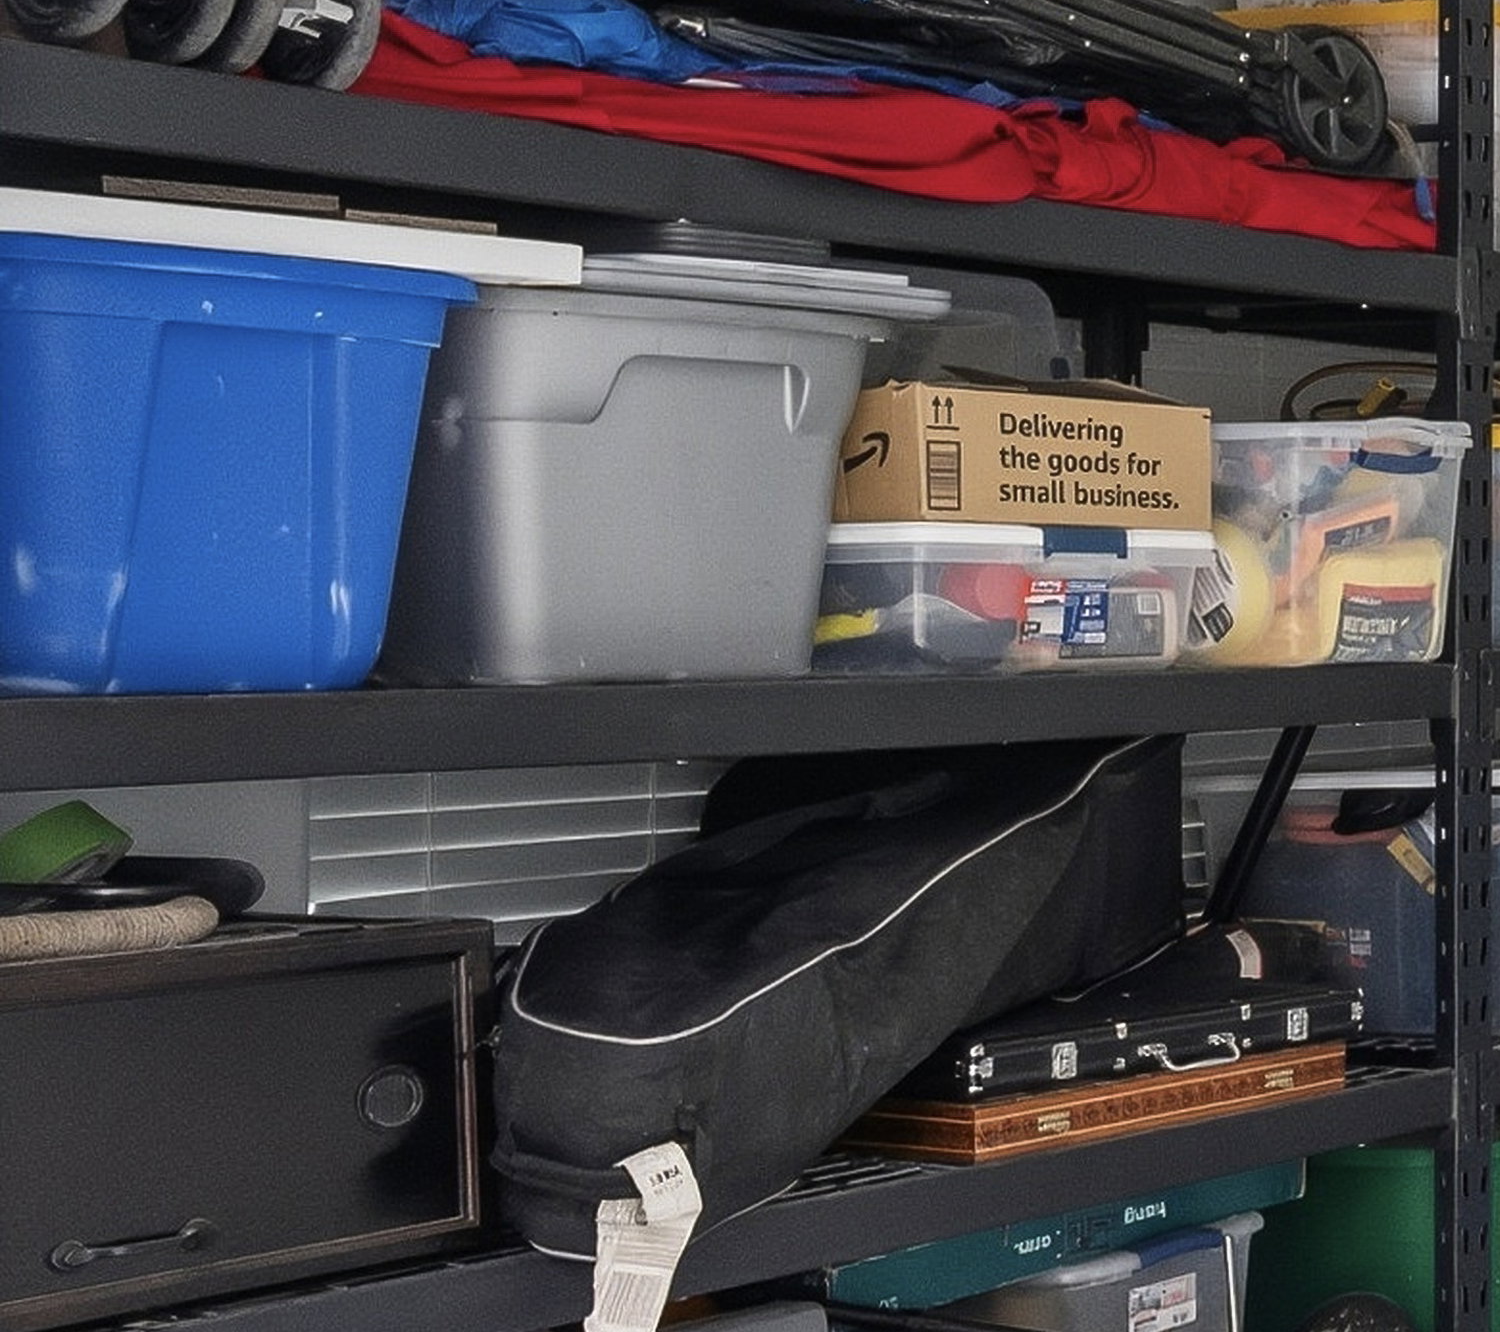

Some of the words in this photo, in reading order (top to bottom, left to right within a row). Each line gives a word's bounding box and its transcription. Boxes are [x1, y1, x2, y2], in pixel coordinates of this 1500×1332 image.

[1000, 412, 1124, 448] Delivering
[1000, 445, 1041, 470] the
[1047, 450, 1120, 476] goods
[1127, 452, 1162, 476] for
[999, 480, 1066, 505] small
[1074, 480, 1180, 510] business.
